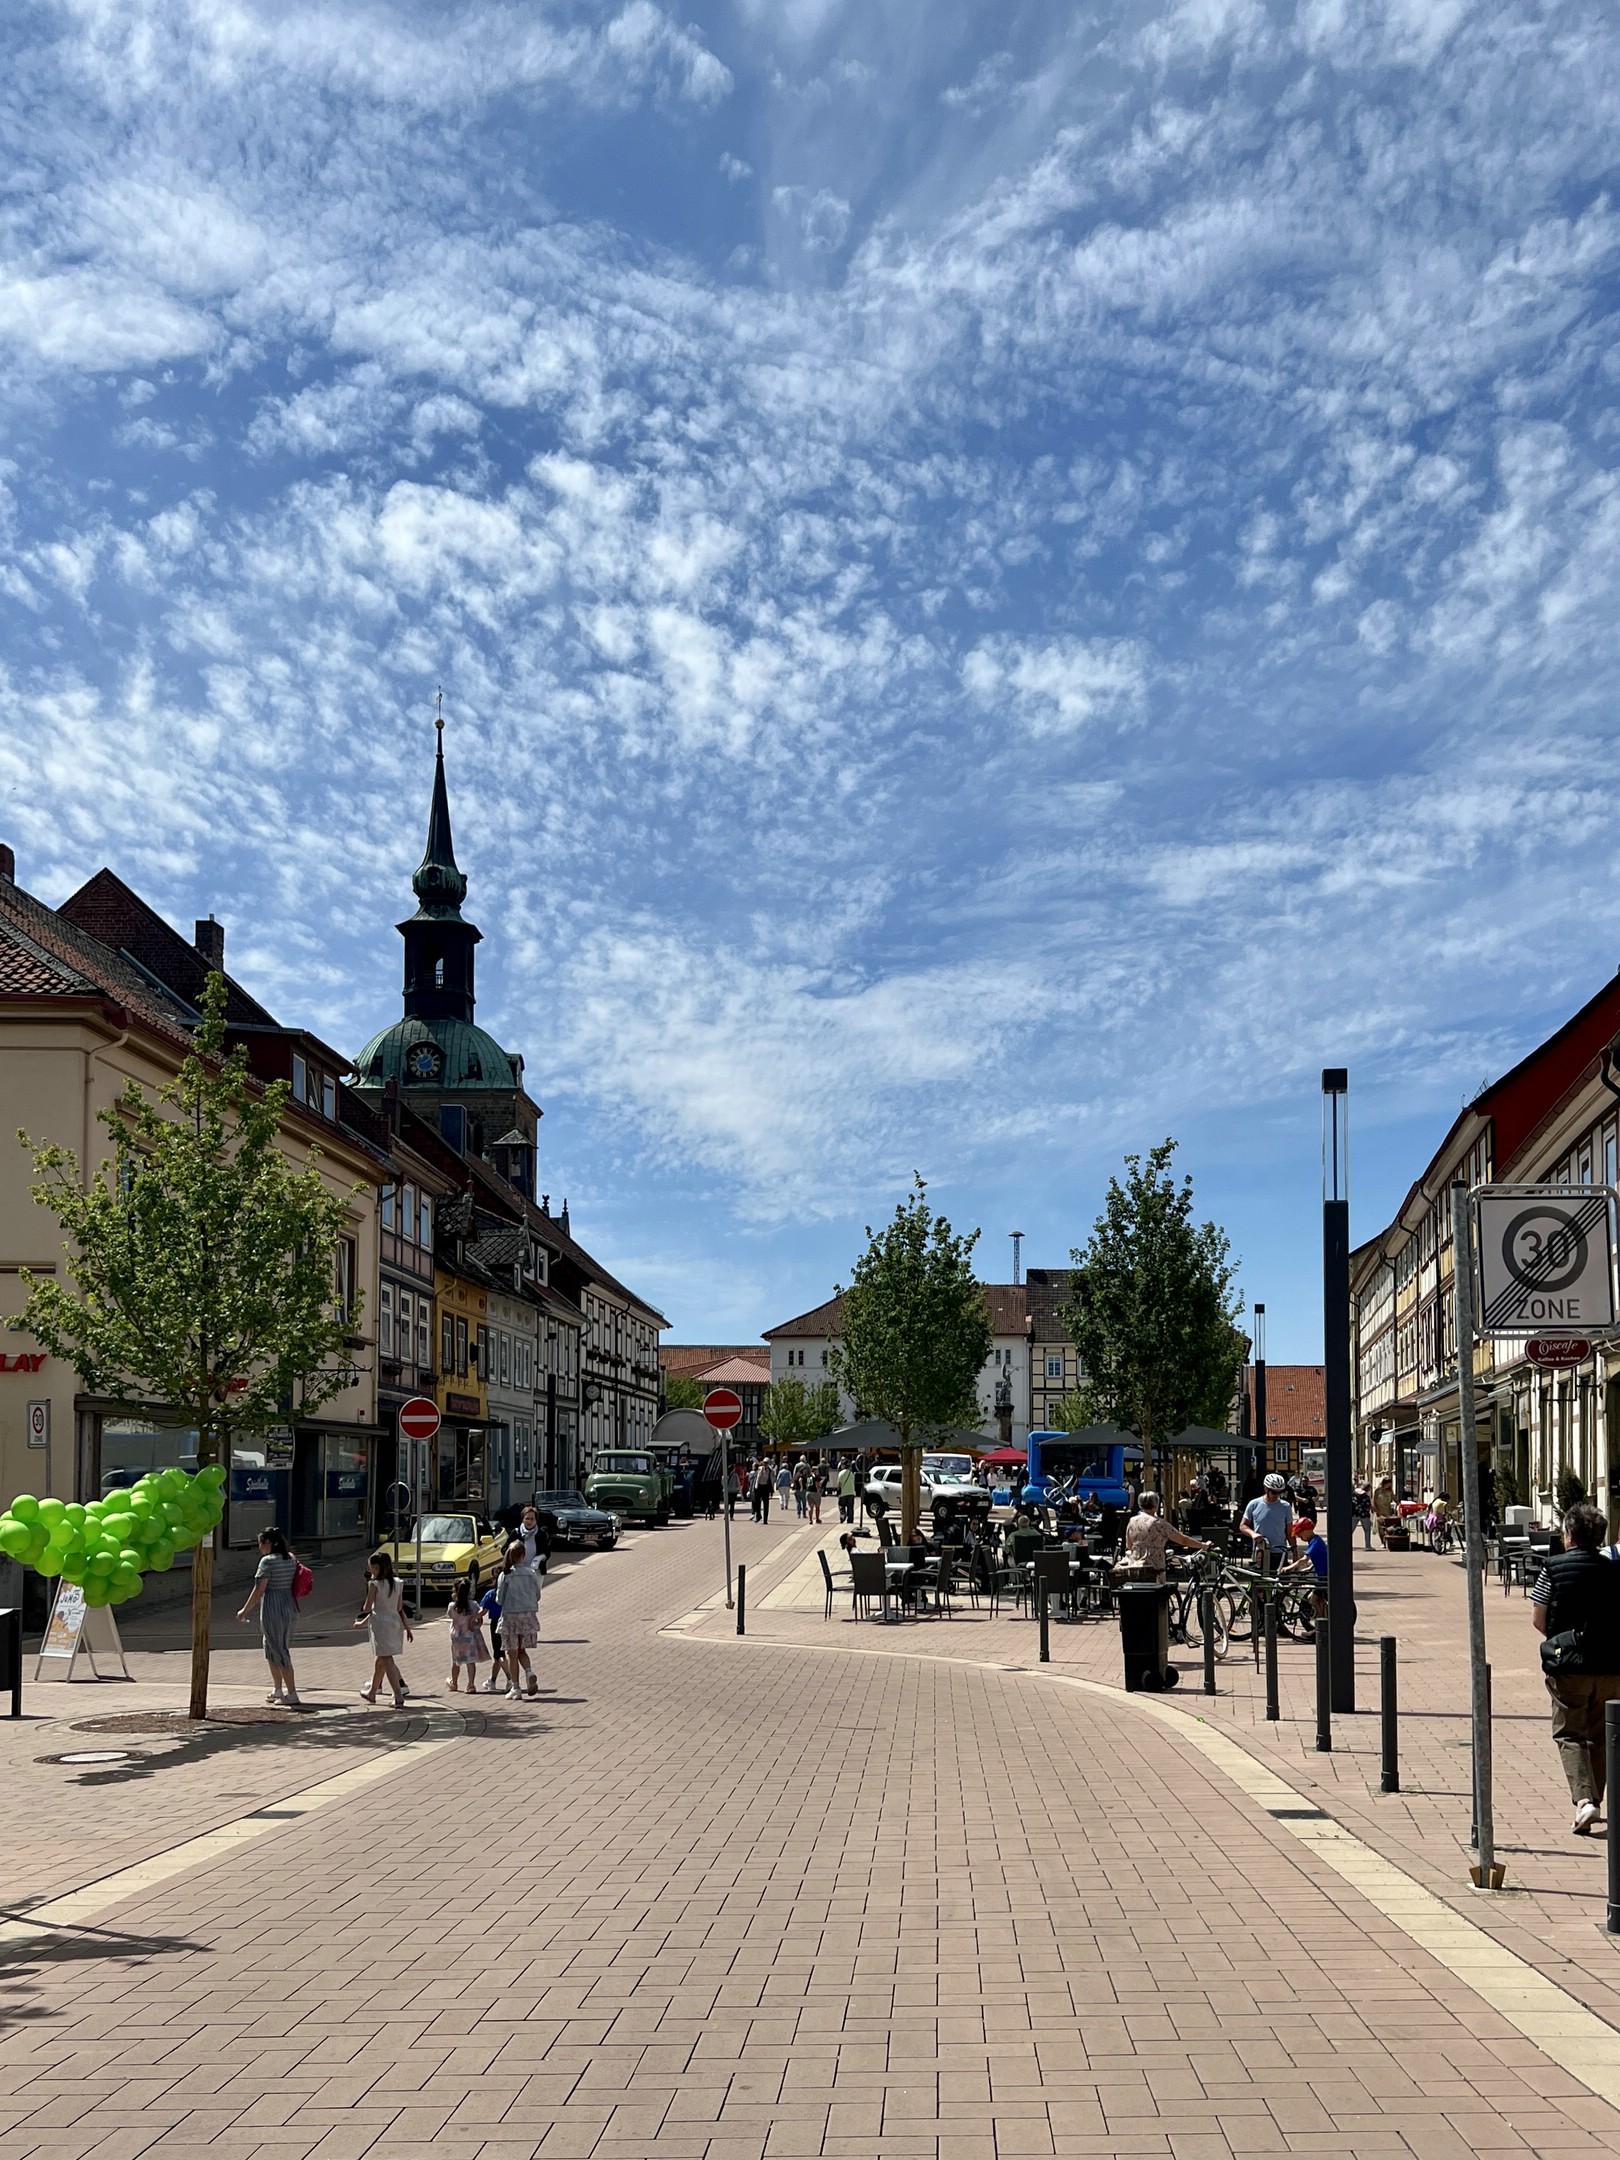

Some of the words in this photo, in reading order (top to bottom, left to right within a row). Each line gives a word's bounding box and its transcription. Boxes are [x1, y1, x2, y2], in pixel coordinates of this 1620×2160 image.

[1520, 1230, 1570, 1268] 30
[1516, 1298, 1581, 1319] ZONE
[35, 1414, 42, 1426] 30
